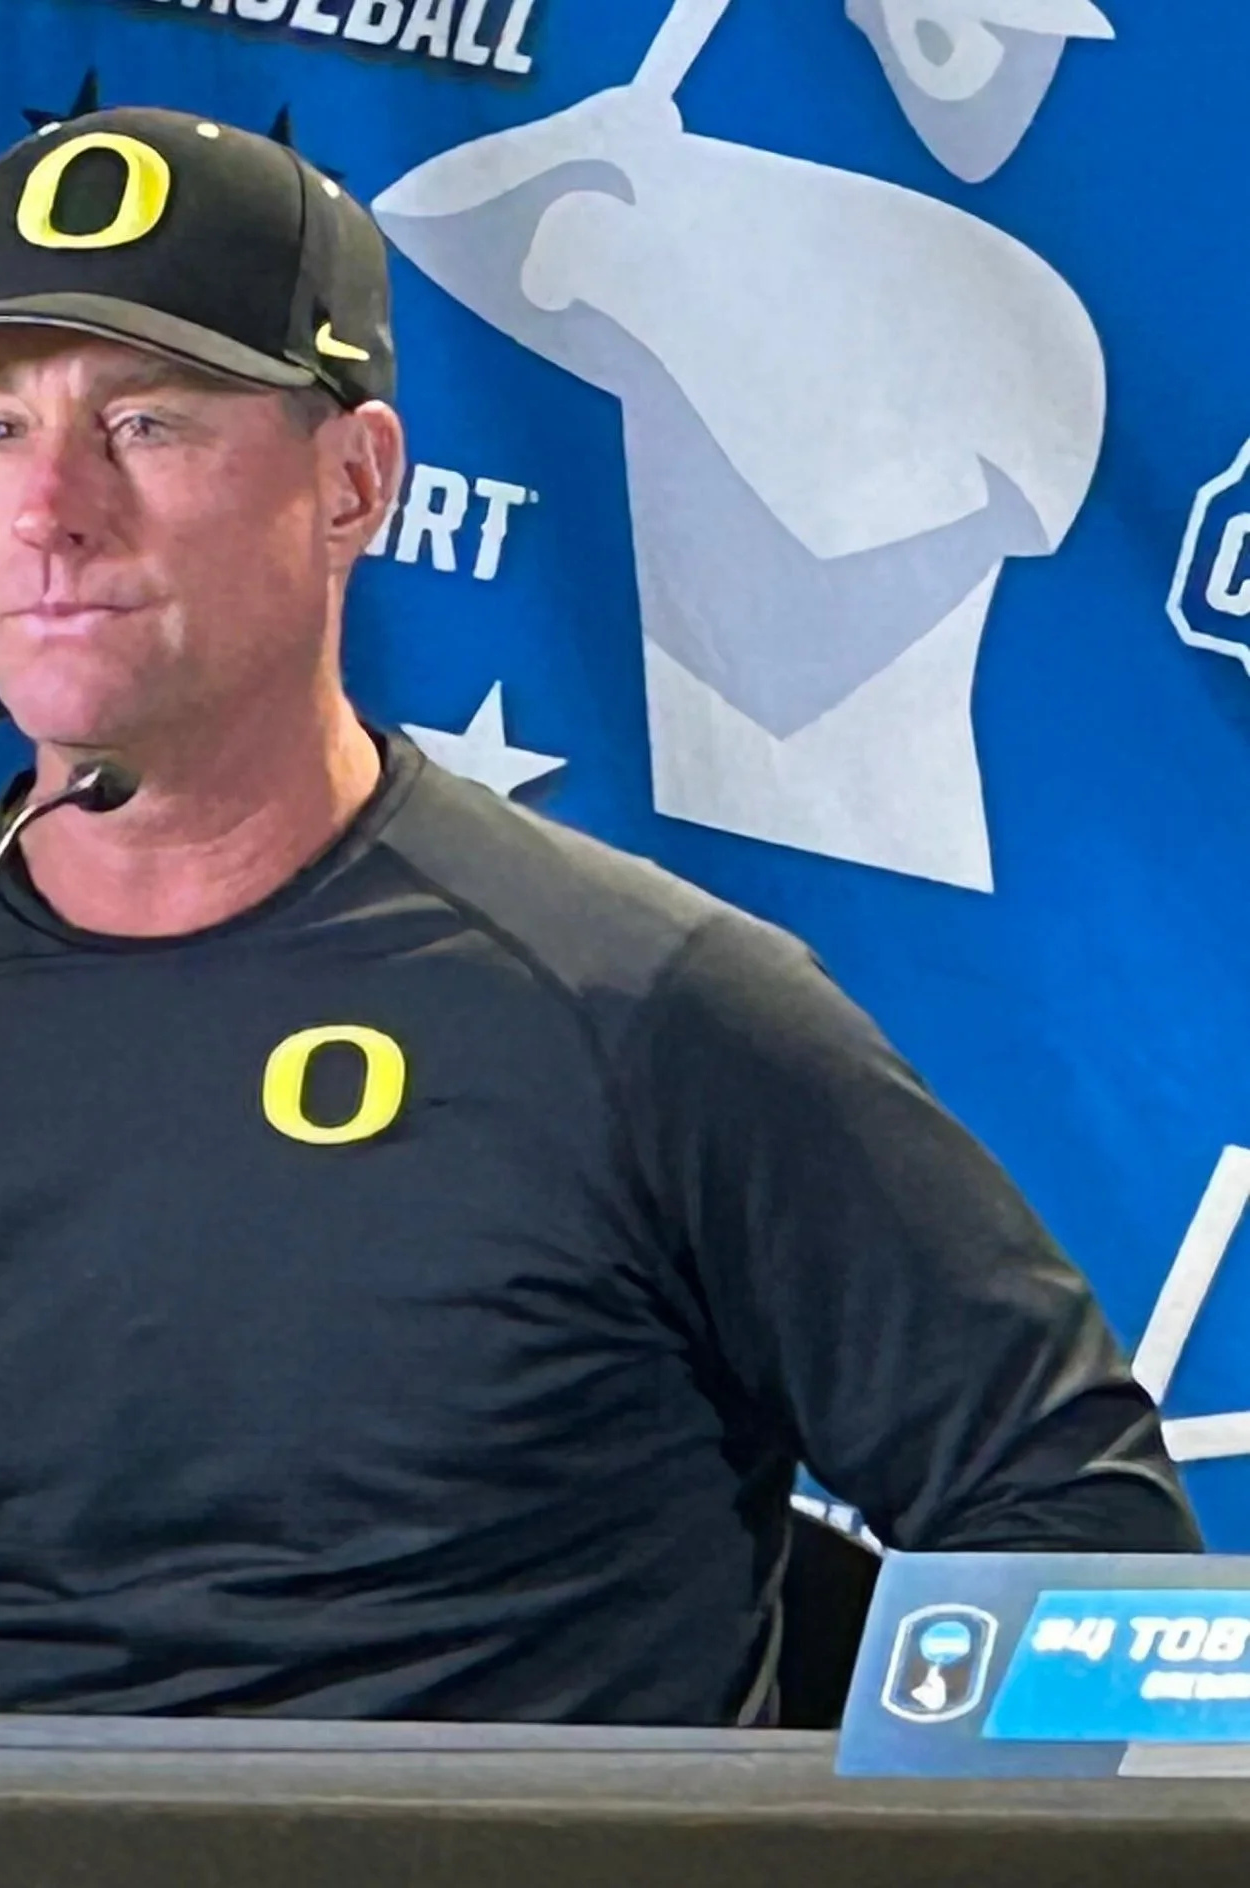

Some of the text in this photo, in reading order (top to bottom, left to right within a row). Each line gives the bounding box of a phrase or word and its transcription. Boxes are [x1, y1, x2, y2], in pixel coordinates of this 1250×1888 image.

[16, 132, 171, 250] O
[364, 463, 527, 581] RT
[262, 1024, 406, 1145] O
